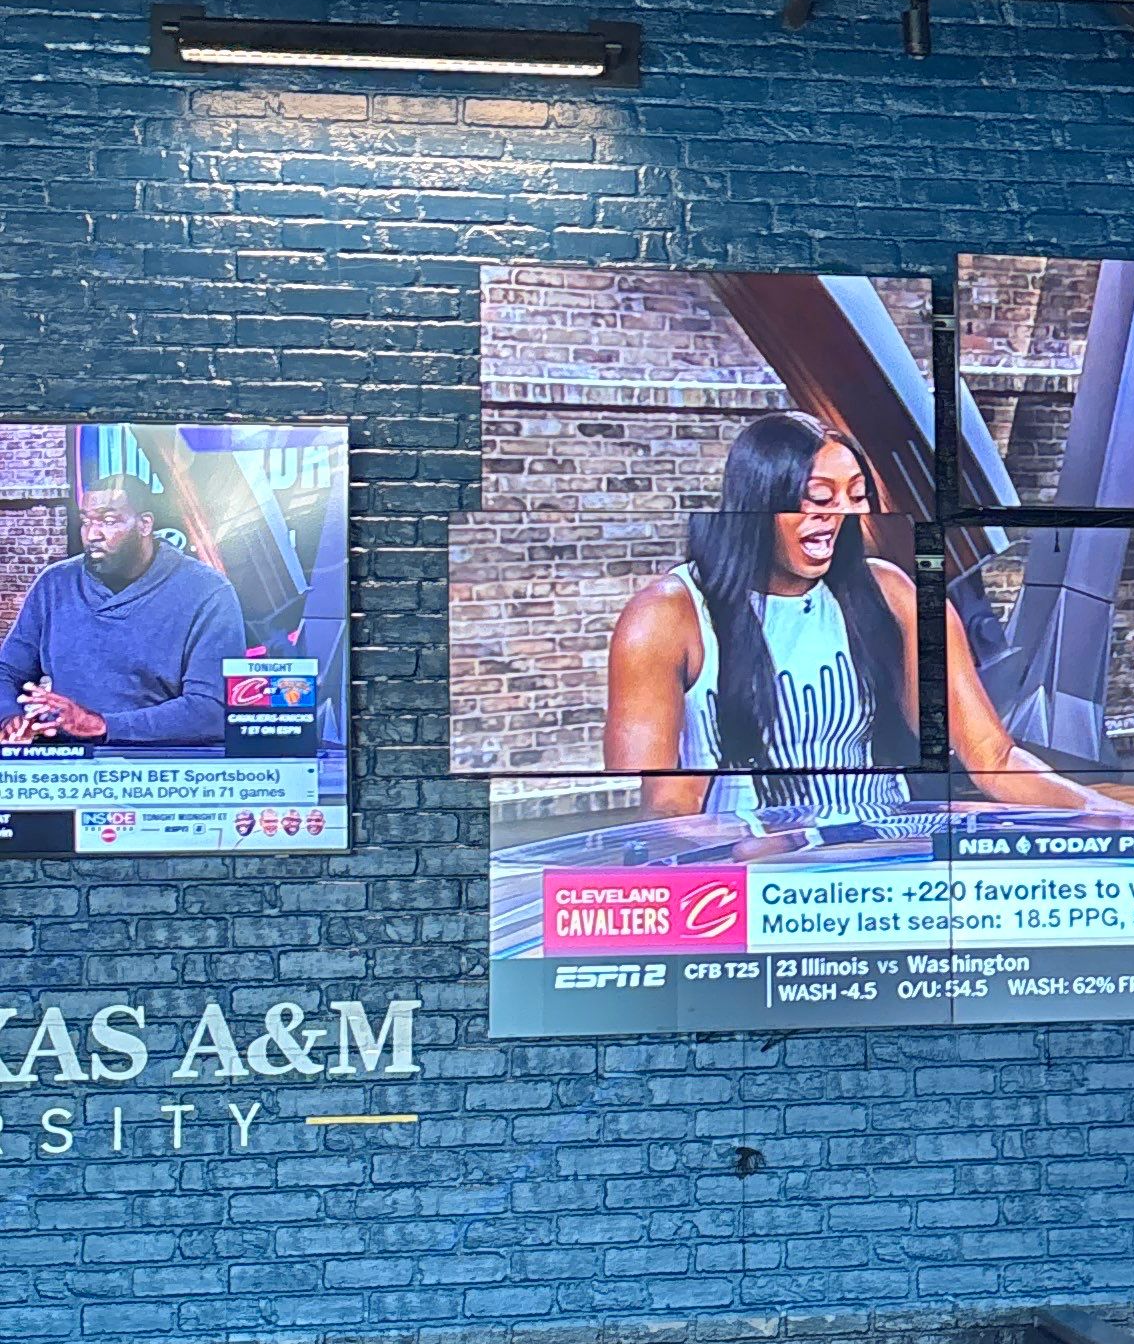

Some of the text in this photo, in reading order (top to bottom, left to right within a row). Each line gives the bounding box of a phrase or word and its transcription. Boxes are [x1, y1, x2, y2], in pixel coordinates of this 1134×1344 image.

[249, 663, 293, 672] TONIGHT
[23, 746, 85, 756] HYUNDAI
[31, 773, 88, 784] season
[94, 770, 142, 785] (ESPN
[148, 770, 180, 782] BET
[184, 769, 280, 785] Sportsbook)
[18, 787, 54, 801] RPG,
[58, 787, 79, 799] 3.2
[82, 787, 118, 800] APG,
[122, 787, 153, 798] NBA
[158, 787, 199, 798] DPOY
[203, 786, 216, 797] in
[220, 787, 234, 797] 71
[240, 788, 286, 799] games
[959, 838, 1011, 854] NBA
[1035, 837, 1112, 853] TODAY
[555, 888, 670, 905] CLEVELAND
[762, 882, 893, 905] Cavaliers:
[902, 880, 966, 903] +220
[975, 879, 1087, 901] favorites
[1096, 879, 1120, 899] to
[556, 908, 670, 937] CAVALIERS
[762, 913, 850, 936] Mobley
[857, 912, 901, 932] last
[908, 913, 1001, 931] season:
[1014, 908, 1061, 929] 18.5
[1069, 907, 1125, 930] PPG,
[684, 962, 722, 980] CFB
[724, 961, 760, 978] T25
[776, 959, 797, 977] 23
[801, 957, 869, 976] Illinois
[877, 959, 899, 975] vs
[907, 953, 1030, 976] Washington
[778, 983, 837, 1002] WASH
[840, 981, 878, 1000] -4.5
[898, 981, 942, 998] O/U:
[945, 978, 988, 998] 54.5
[1007, 977, 1069, 996] WASH:
[1072, 976, 1115, 994] 62%
[172, 1000, 422, 1077] A&M
